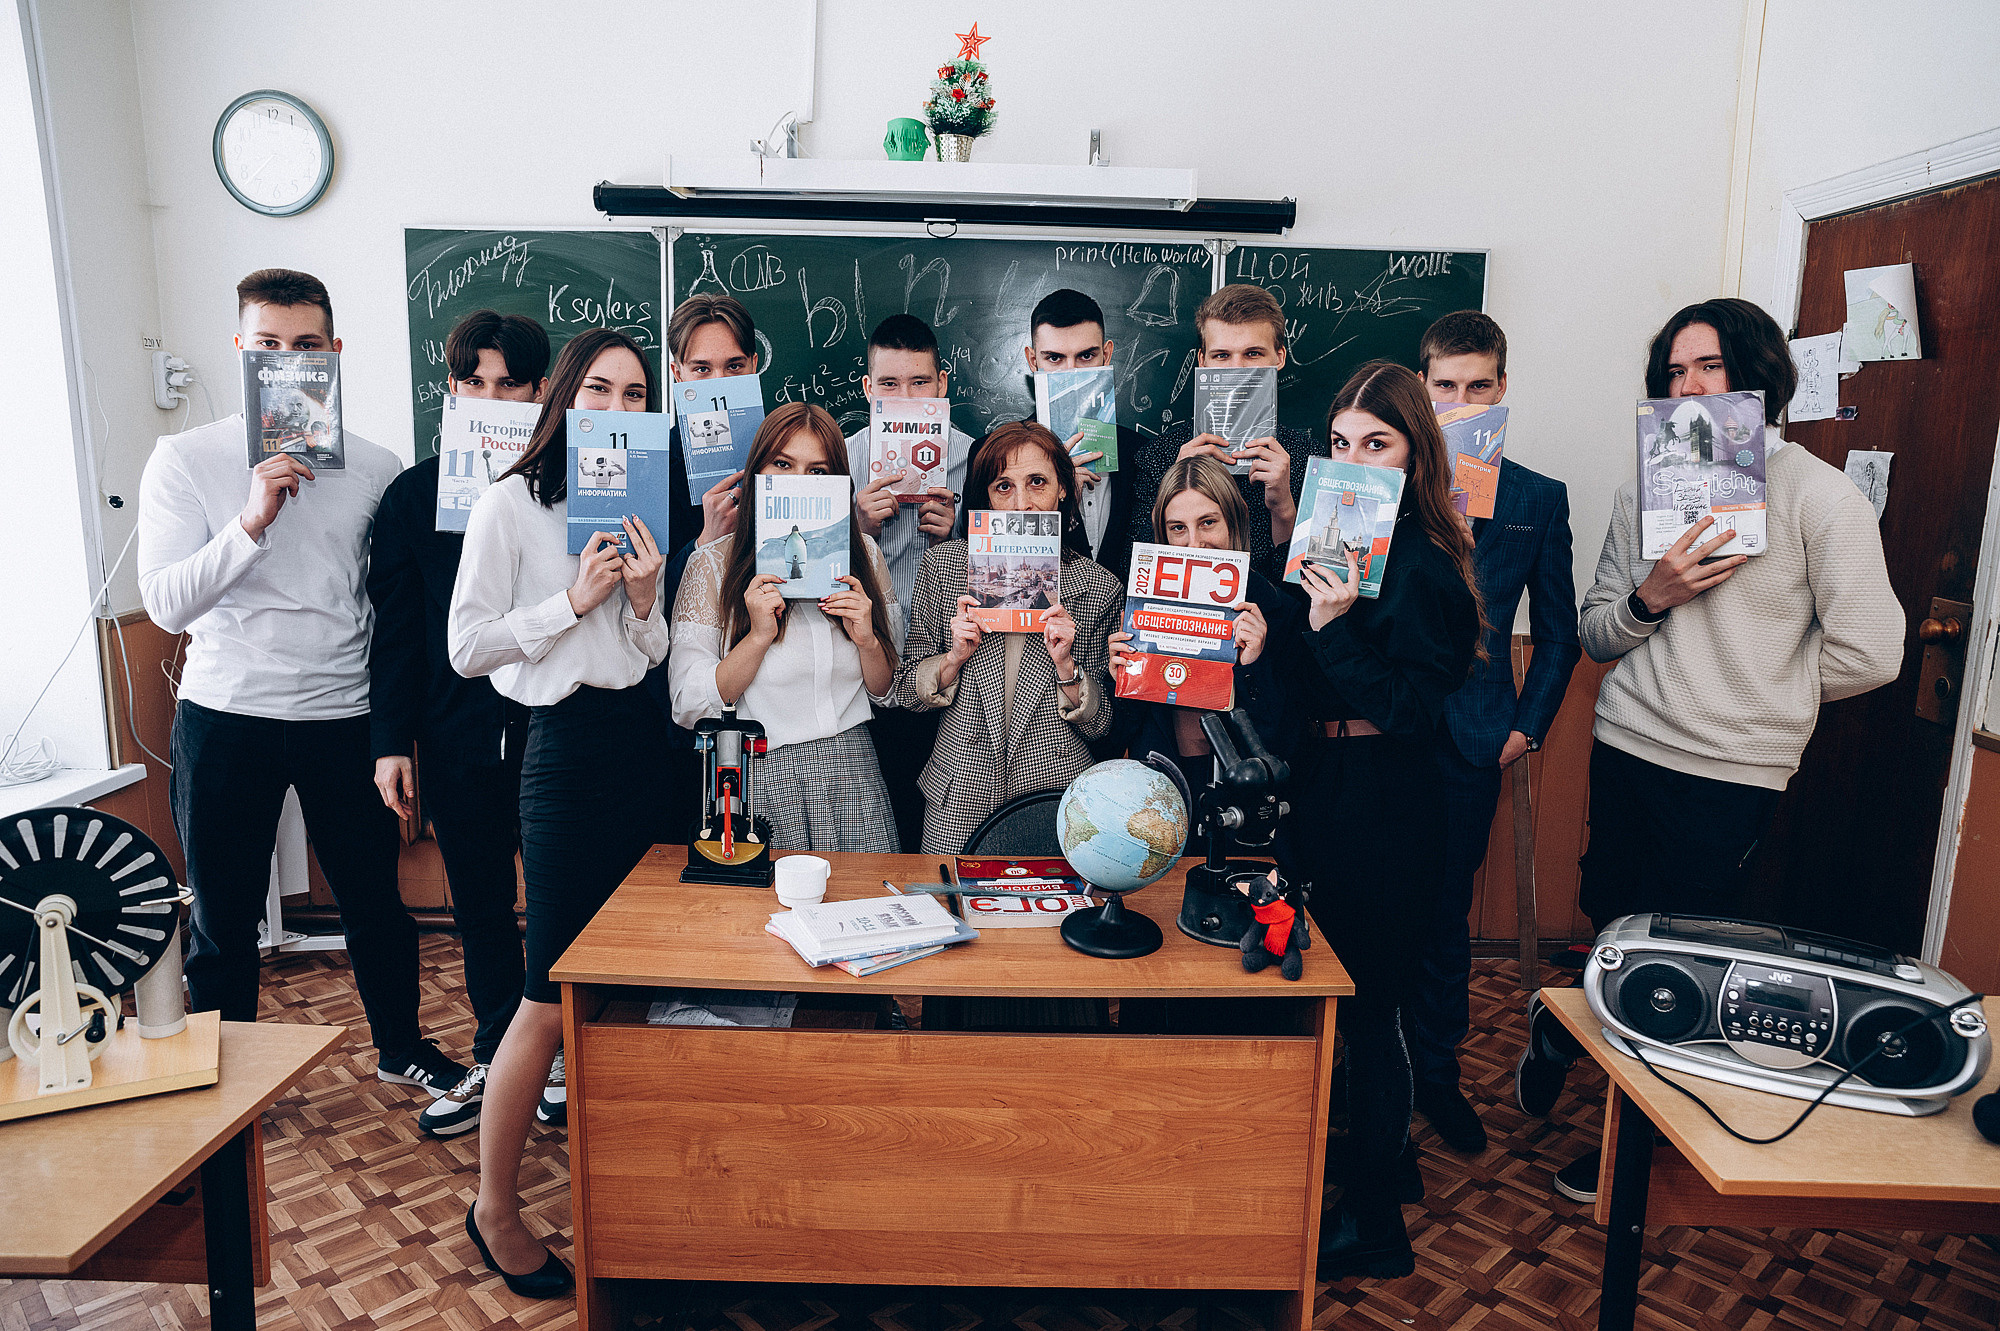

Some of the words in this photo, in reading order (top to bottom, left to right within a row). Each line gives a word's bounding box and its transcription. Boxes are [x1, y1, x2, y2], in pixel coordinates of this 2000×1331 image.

[267, 108, 279, 125] 12
[1236, 247, 1311, 286] ЦОЙ
[547, 277, 653, 331] Ksylers
[257, 366, 329, 385] физика
[710, 395, 728, 411] 11
[1088, 391, 1105, 408] 11
[881, 421, 942, 435] ХИМИЯ
[265, 440, 278, 451] 11
[480, 436, 530, 453] Росси
[609, 432, 628, 449] 11
[1473, 428, 1492, 446] 11
[691, 444, 735, 457] ИНФОРМАТИКА
[919, 450, 933, 462] 11
[443, 448, 477, 479] 11
[1458, 458, 1493, 475] Геометрия
[577, 488, 628, 498] ИНФОРМАТИКА
[1317, 476, 1386, 496] ОБЩЕСТВОЗНАНИЕ
[765, 495, 832, 520] БИОЛОГИЯ
[976, 535, 1055, 554] ЛИТЕРАТУРА
[829, 562, 842, 580] 11
[1152, 555, 1241, 604] ЕГЭ
[1135, 567, 1151, 595] 2022
[1018, 612, 1032, 627] 11
[1136, 614, 1229, 637] ОБЩЕСТВОЗНАНИЕ
[1168, 666, 1182, 679] 30
[969, 896, 1069, 913] ОГЭ
[1768, 971, 1794, 984] JVC
